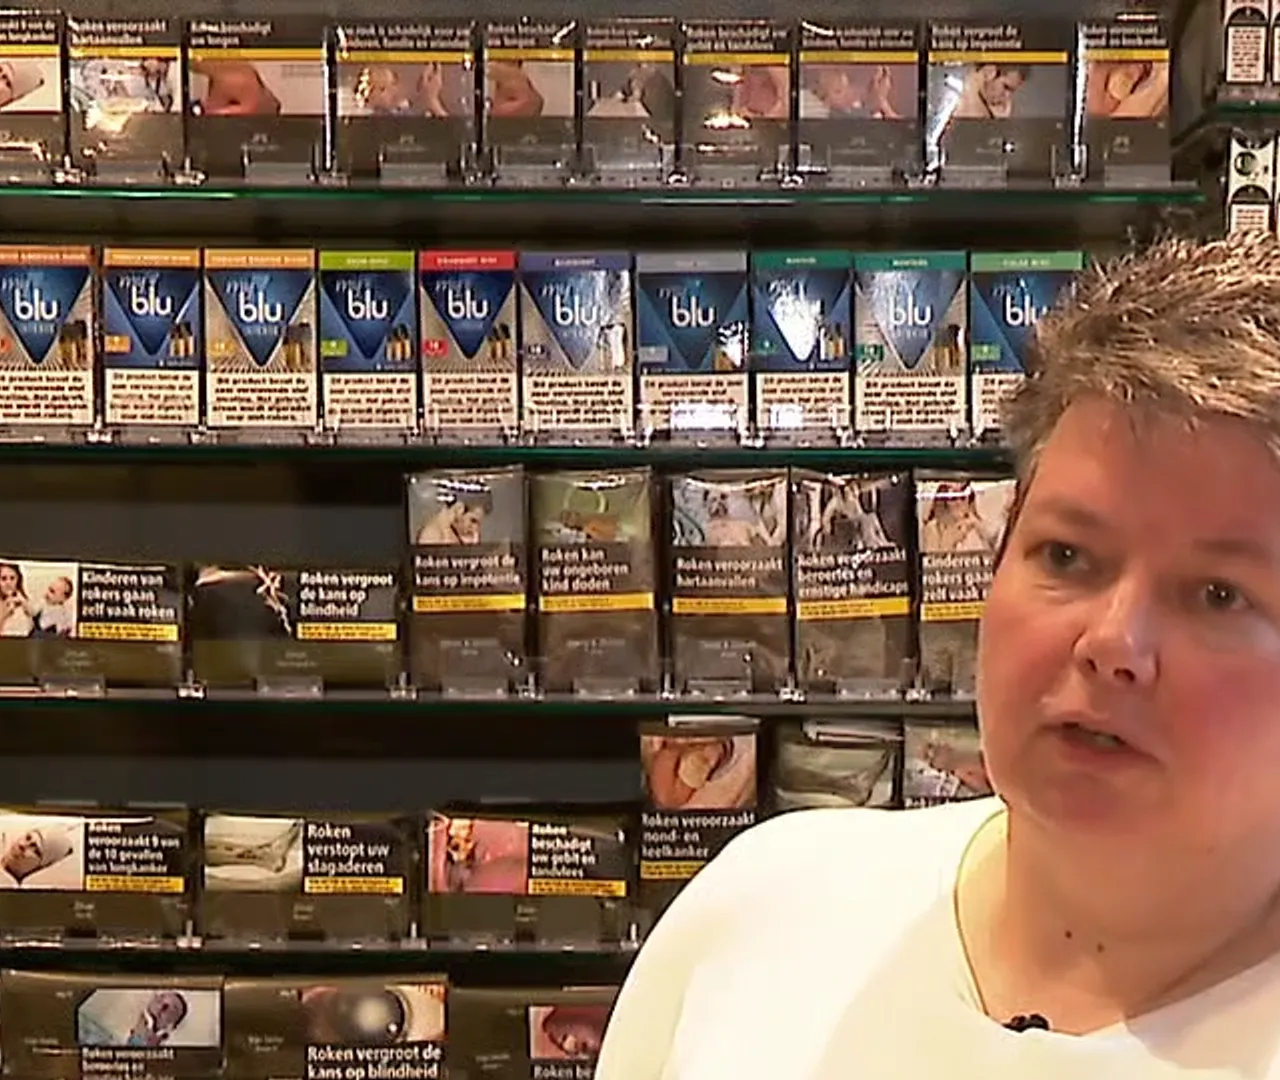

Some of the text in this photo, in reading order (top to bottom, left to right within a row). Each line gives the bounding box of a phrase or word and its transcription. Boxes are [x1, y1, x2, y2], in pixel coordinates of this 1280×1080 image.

[13, 288, 59, 322] blu
[131, 287, 172, 317] blu
[239, 290, 282, 323] blu
[348, 288, 388, 320] blu
[447, 289, 488, 320] blu
[554, 295, 597, 327] blu
[888, 295, 931, 327] blu
[672, 296, 713, 328] blu
[541, 547, 605, 564] Roken kan
[676, 556, 783, 573] Roken veroorzaakt
[81, 570, 163, 586] Kinderen van
[563, 562, 629, 578] ongeboren
[299, 572, 394, 589] Roken vergroot
[541, 576, 610, 592] kind doden
[676, 573, 757, 589] hartaanvallen
[81, 586, 155, 604] rokers gaan
[299, 587, 365, 604] de kans op
[81, 603, 175, 618] zelf vaak roken
[299, 601, 359, 617] blindheid
[307, 823, 351, 839] Roken
[307, 842, 389, 860] verstopt uw
[307, 859, 384, 877] slagaderen
[308, 1046, 441, 1064] Roken vergroot de
[308, 1064, 342, 1080] kans
[368, 1062, 438, 1080] blindheid
